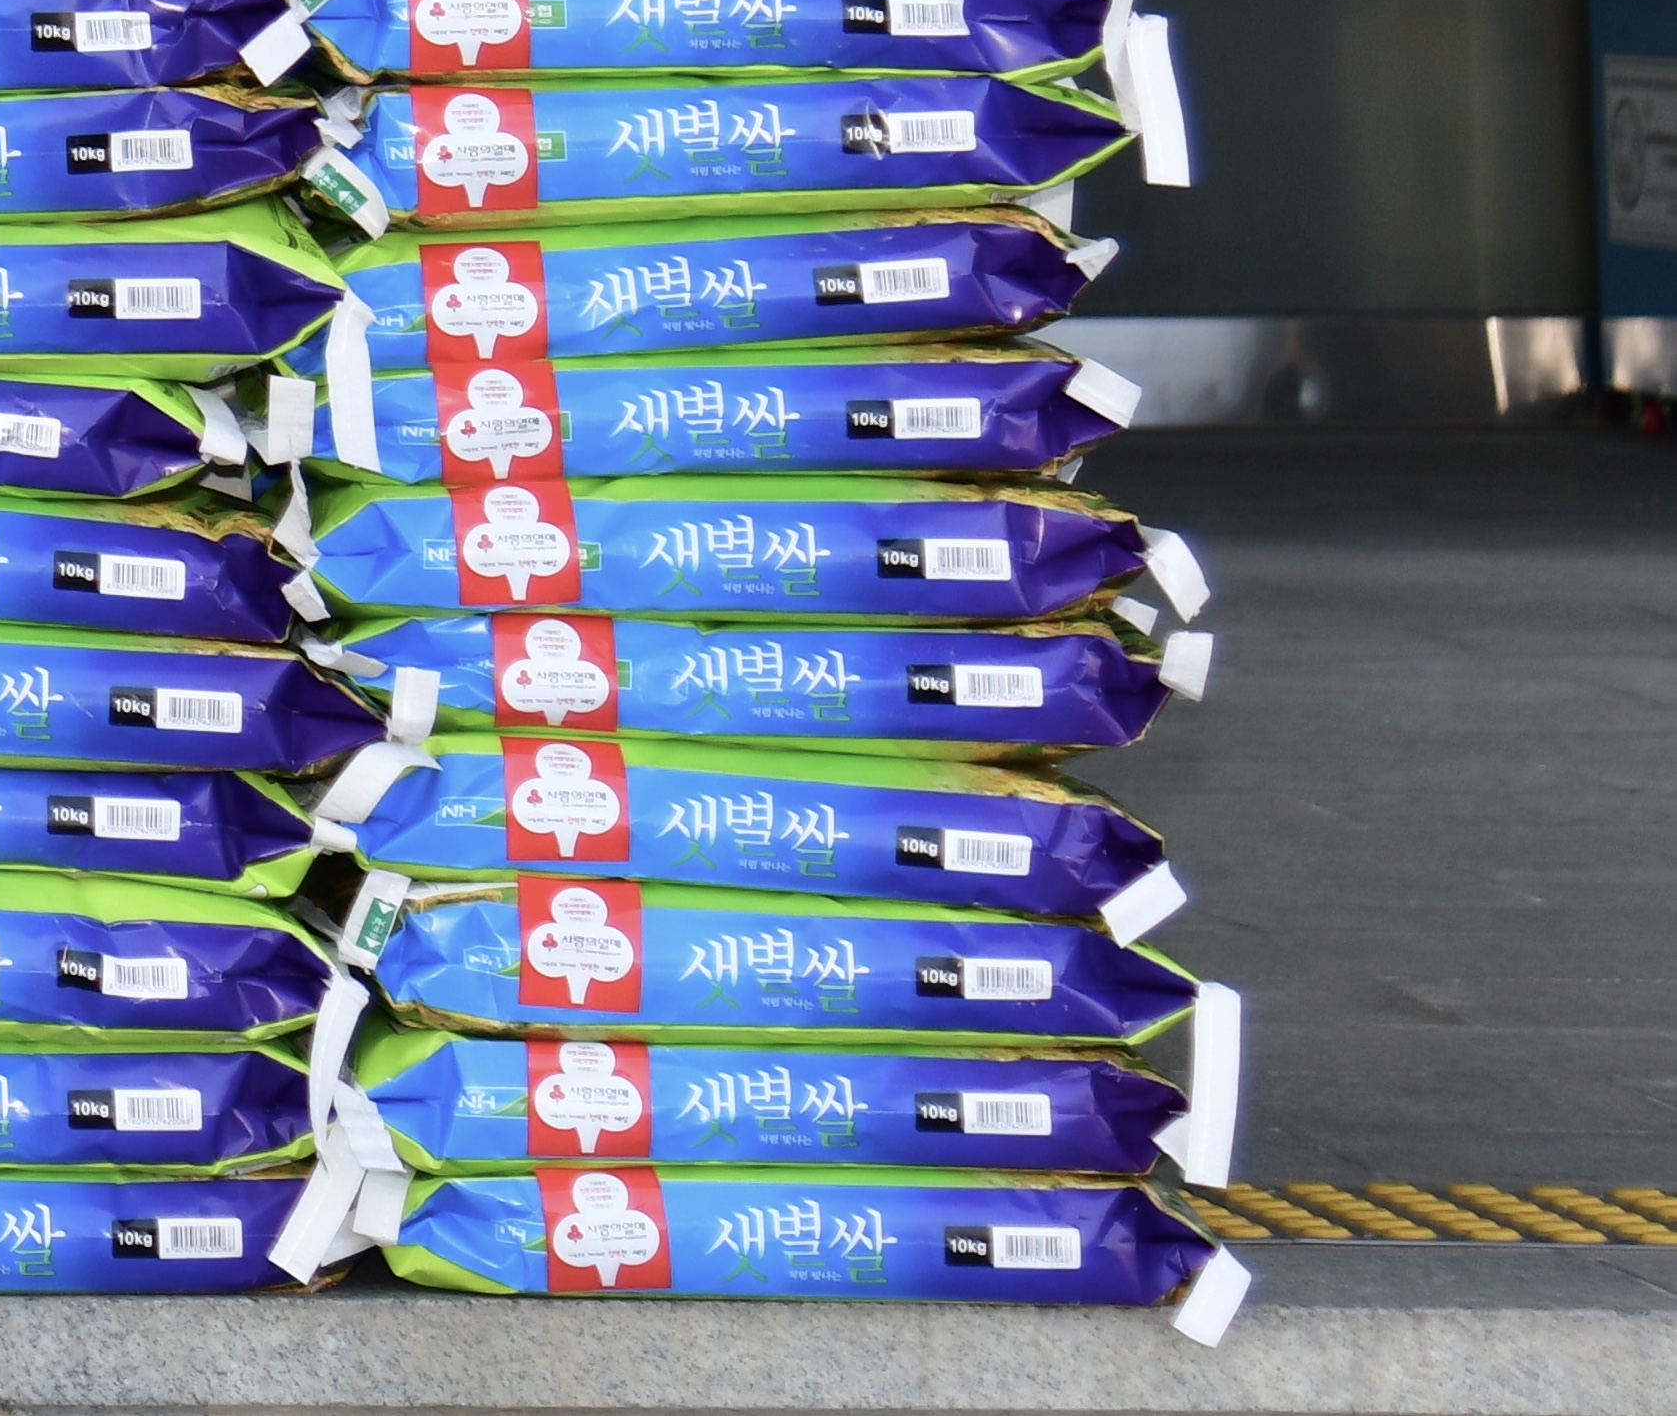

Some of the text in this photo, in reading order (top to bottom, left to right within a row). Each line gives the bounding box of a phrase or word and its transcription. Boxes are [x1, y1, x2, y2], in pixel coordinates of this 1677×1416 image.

[846, 5, 885, 24] 10kg
[71, 145, 106, 163] 10kg
[52, 805, 88, 825] 10kg
[949, 1238, 988, 1256] 10kg
